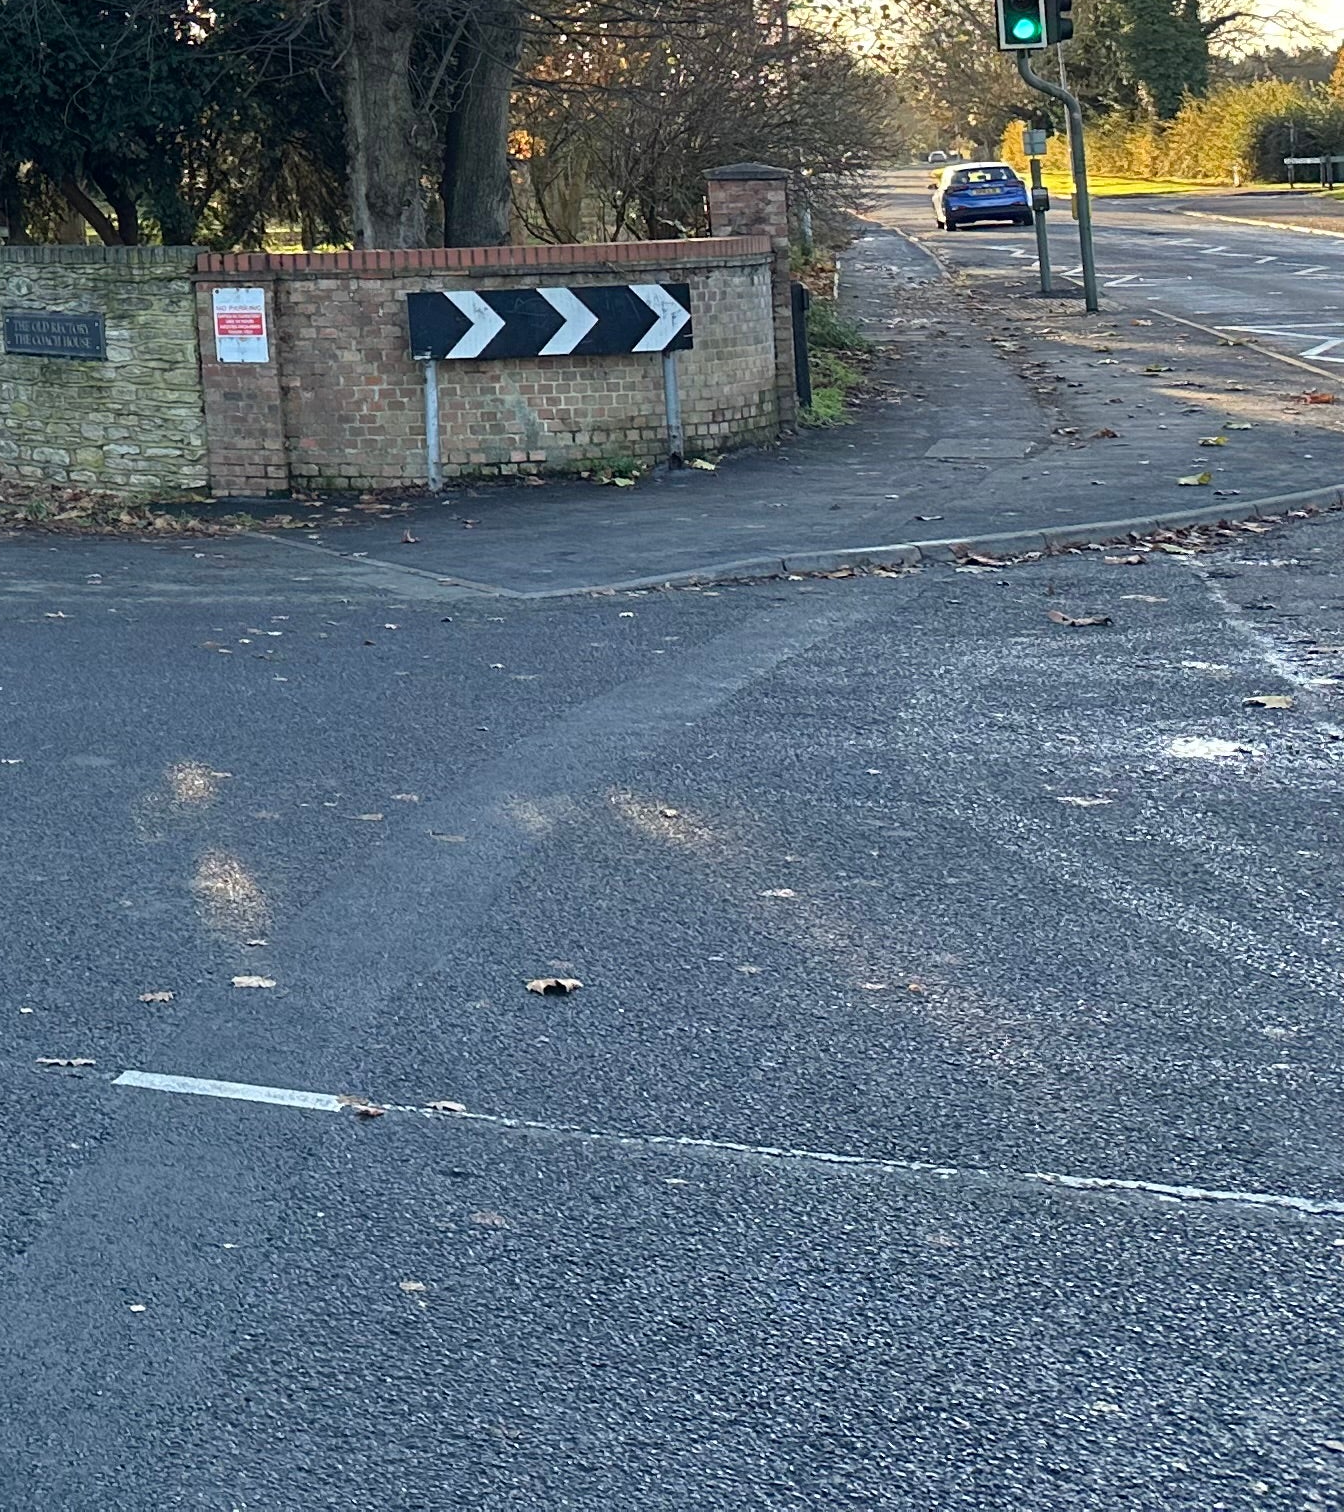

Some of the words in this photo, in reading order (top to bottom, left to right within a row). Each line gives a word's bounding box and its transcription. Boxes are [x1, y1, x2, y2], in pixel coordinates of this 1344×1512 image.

[13, 320, 31, 332] THE
[31, 320, 50, 333] OLD
[14, 333, 31, 345] THE
[31, 334, 62, 347] COACH
[62, 335, 90, 349] HOUSE
